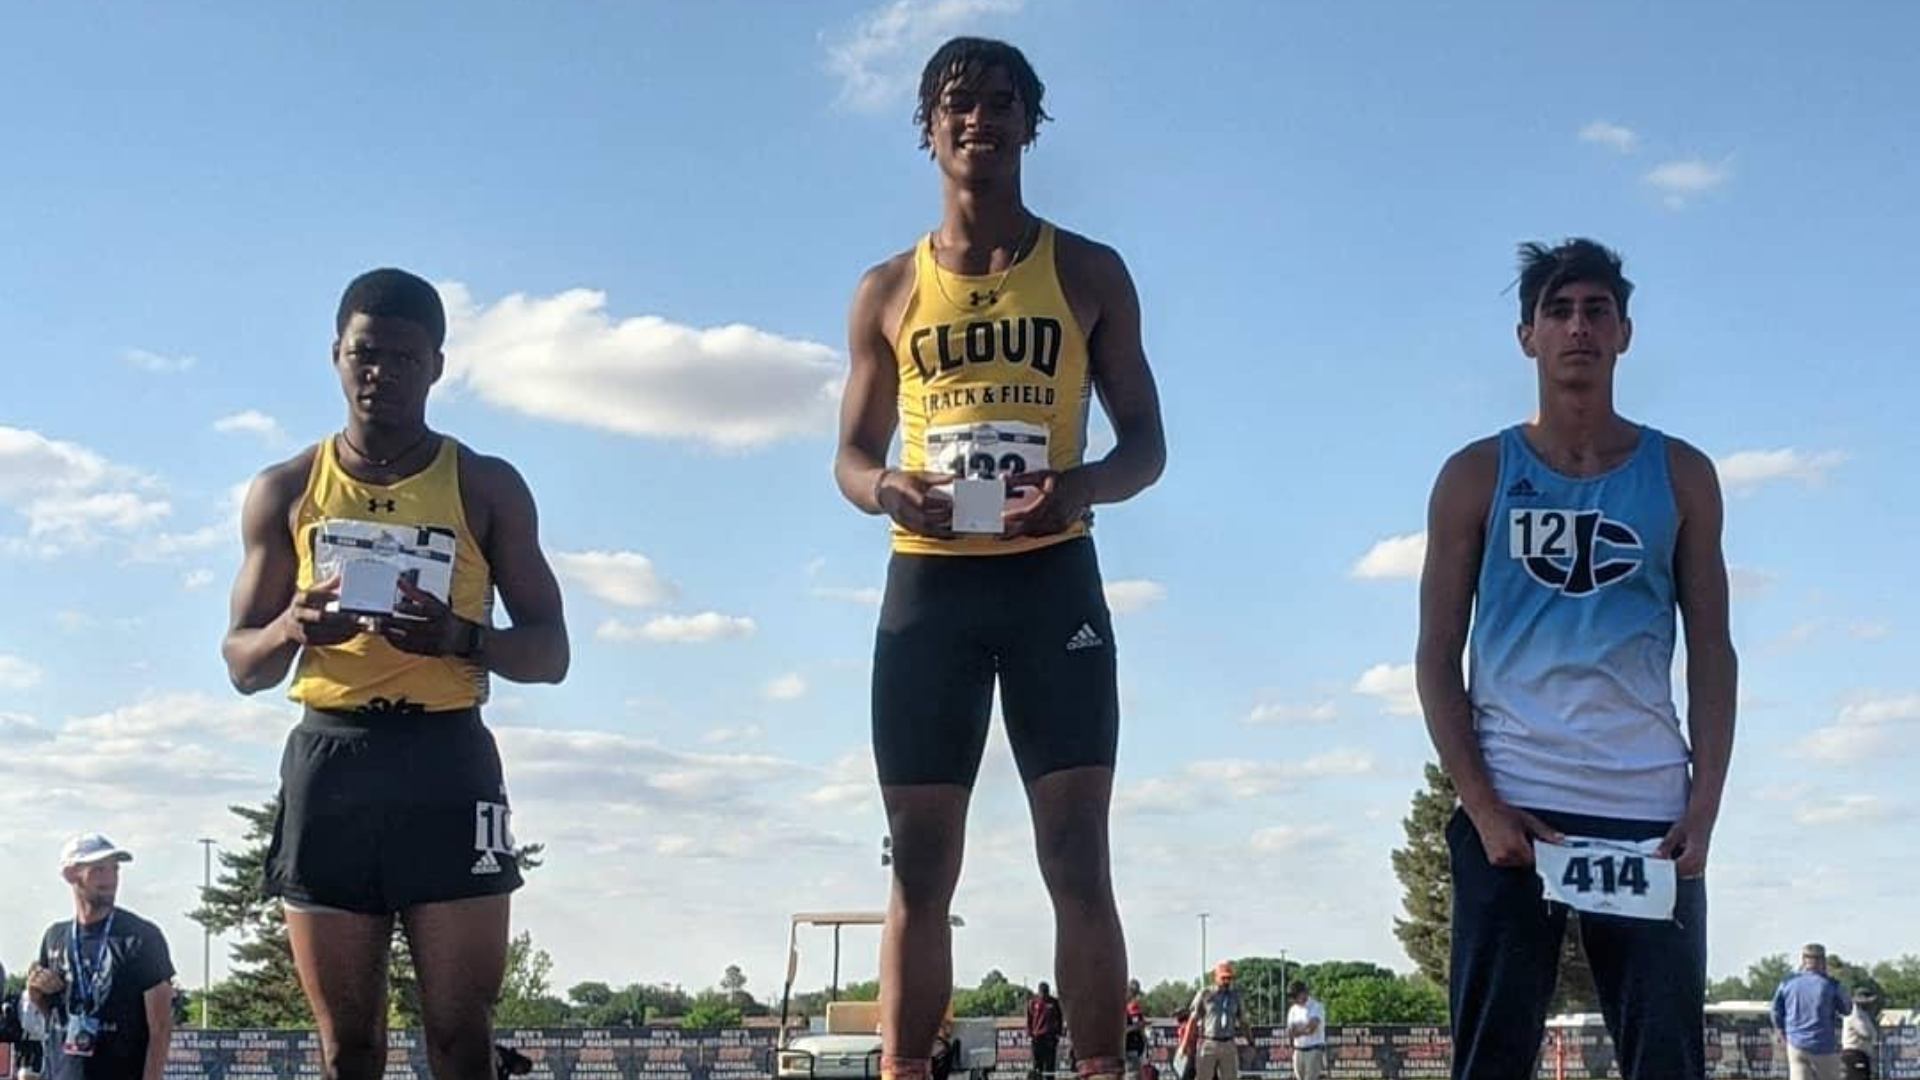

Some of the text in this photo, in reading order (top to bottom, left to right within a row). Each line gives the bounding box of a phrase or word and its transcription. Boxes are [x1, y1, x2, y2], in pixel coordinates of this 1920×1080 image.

[910, 317, 1062, 383] CLOUD
[922, 386, 1055, 411] TRACK & FIELD
[1514, 512, 1566, 556] 12
[1562, 855, 1649, 895] 414
[576, 1062, 618, 1071] NATIONAL
[644, 1062, 688, 1071] NATIONAL
